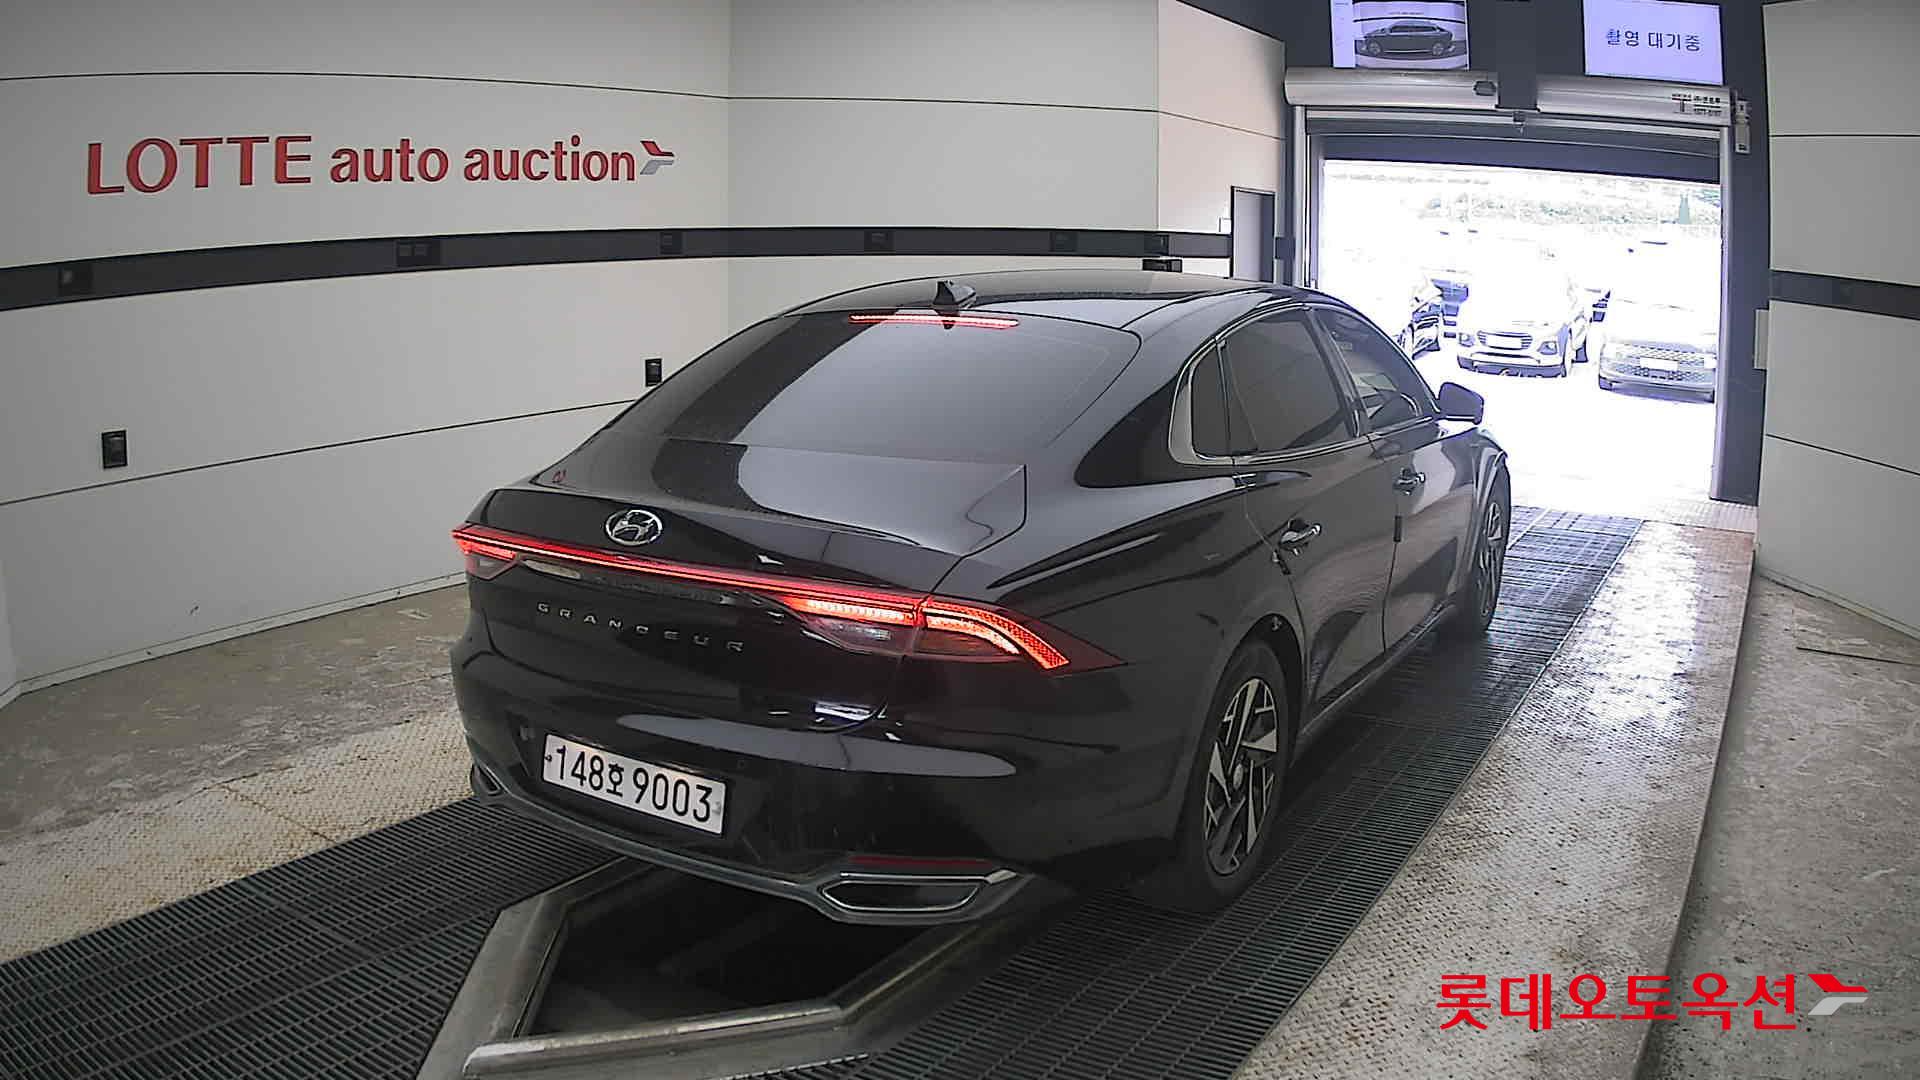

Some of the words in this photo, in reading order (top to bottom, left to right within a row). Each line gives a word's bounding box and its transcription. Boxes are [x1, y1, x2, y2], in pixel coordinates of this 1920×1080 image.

[1648, 32, 1701, 52] 대기중
[87, 135, 312, 194] LOTTE
[329, 138, 449, 182] auto
[463, 134, 635, 182] auction
[537, 602, 744, 652] GRANDEUR
[631, 766, 713, 823] 9003
